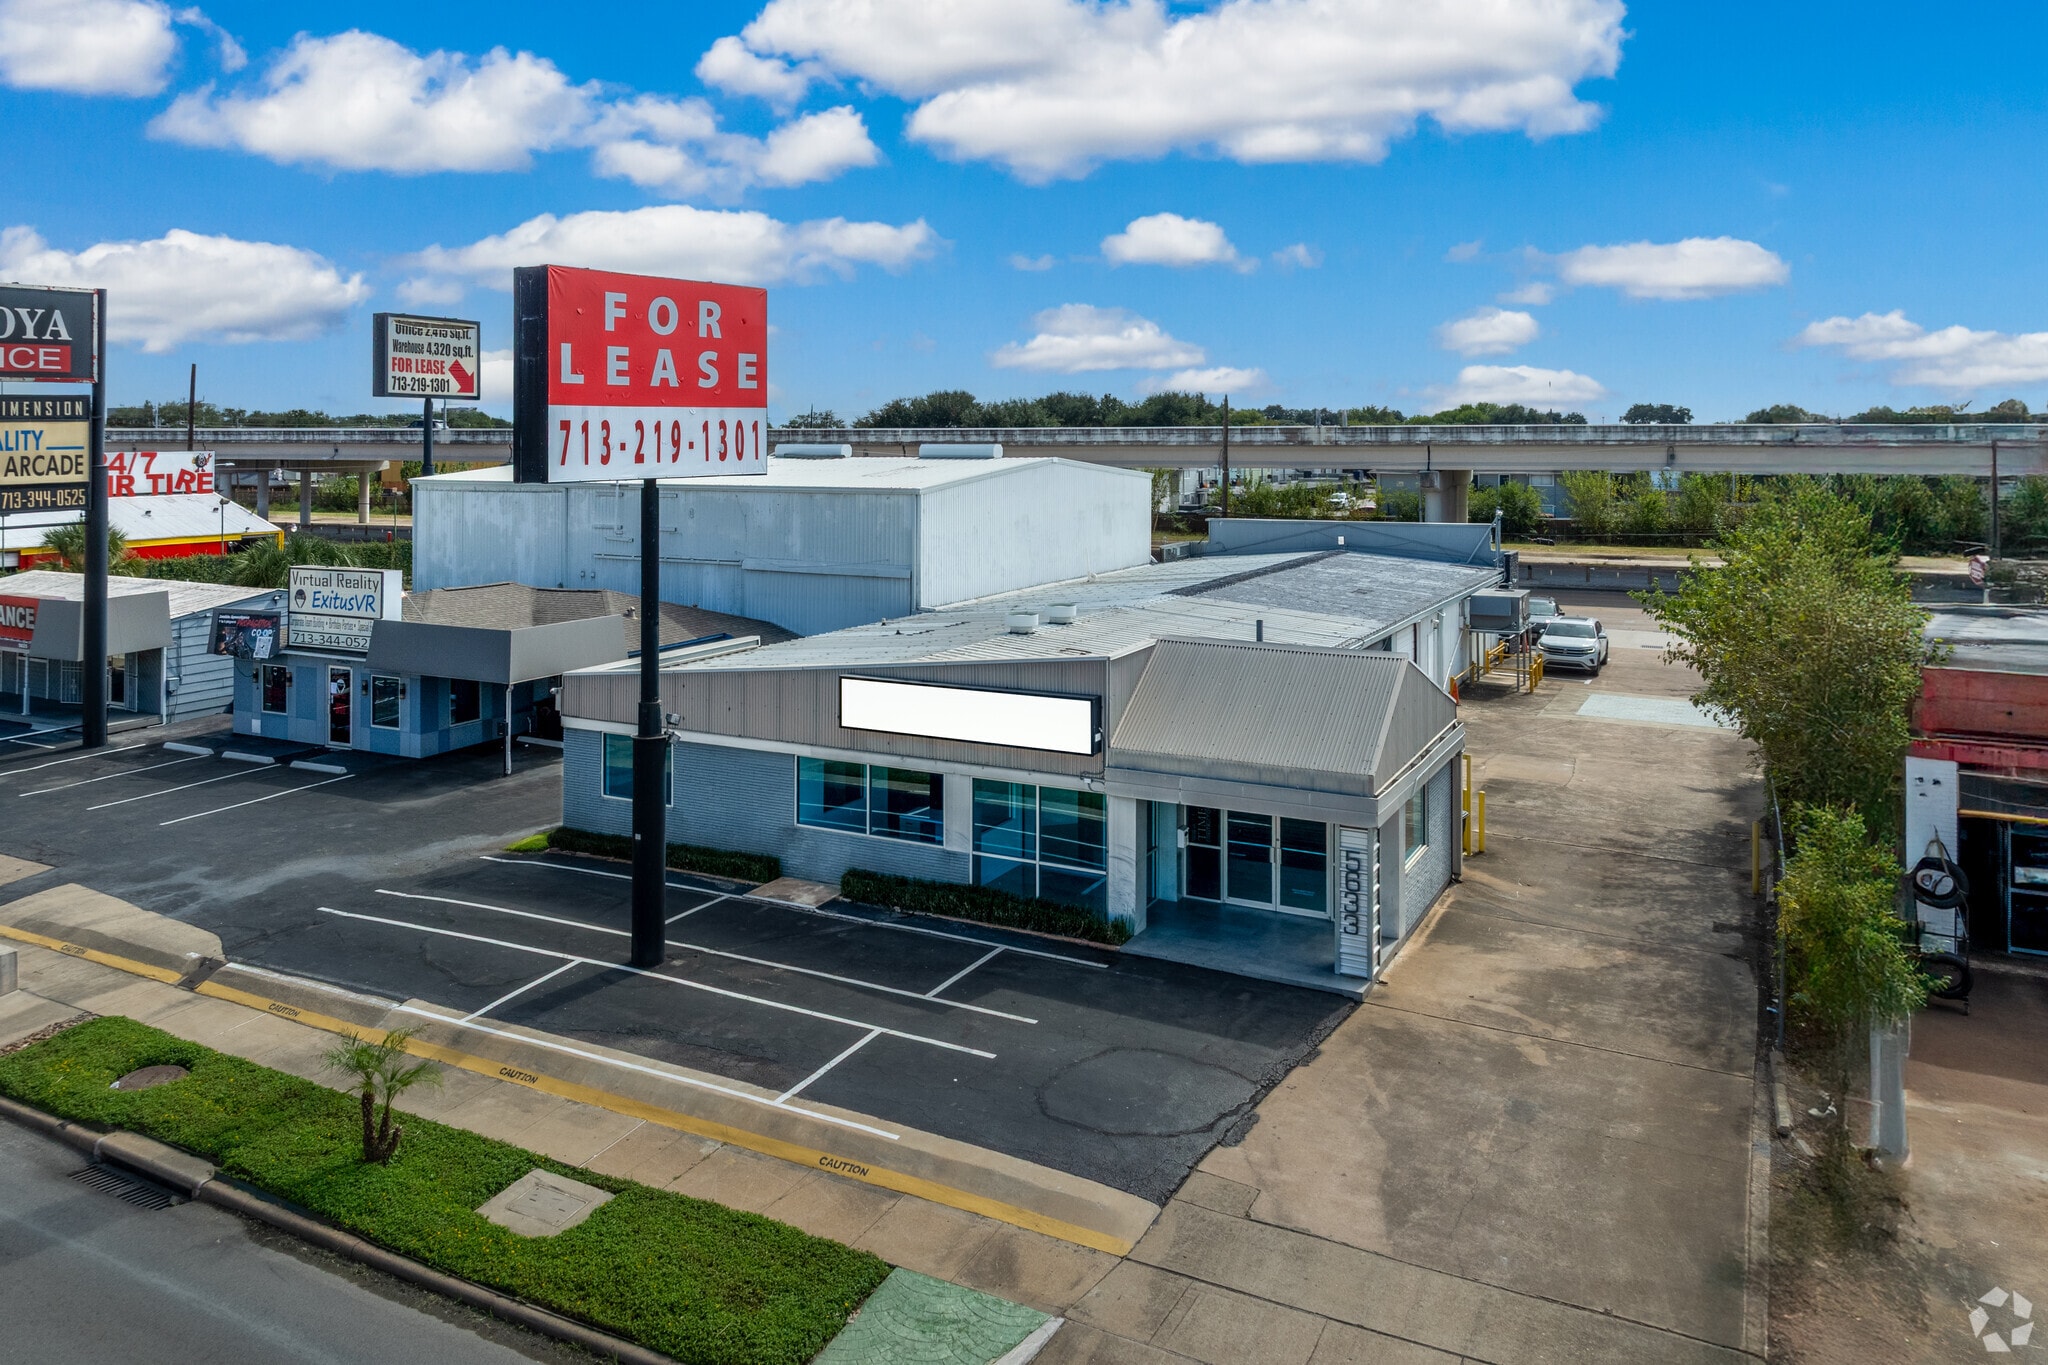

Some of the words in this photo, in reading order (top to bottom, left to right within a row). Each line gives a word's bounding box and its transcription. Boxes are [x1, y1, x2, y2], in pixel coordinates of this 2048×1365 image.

[604, 291, 722, 339] FOR
[0, 346, 62, 370] CE
[392, 338, 424, 355] Warehouse
[426, 342, 451, 357] 4,320
[452, 344, 474, 359] sq.ft.
[391, 356, 413, 373] FOR
[415, 358, 446, 375] LEASE
[560, 342, 758, 389] LEASE
[391, 376, 450, 393] 713-219-1301
[2, 401, 83, 417] IMENSION
[559, 419, 759, 466] 713-219-1301
[3, 454, 84, 477] ARCADE
[103, 451, 157, 475] 4/7
[146, 468, 214, 496] TIRE
[1, 489, 86, 509] 713-344-0525
[292, 571, 332, 587] Virtual
[336, 573, 379, 593] Reality
[312, 590, 376, 613] ExitusVR
[1344, 850, 1361, 936] 5633
[268, 1003, 301, 1017] CAUTION
[499, 1067, 538, 1084] CAUTION
[819, 1156, 869, 1176] CAUTION
